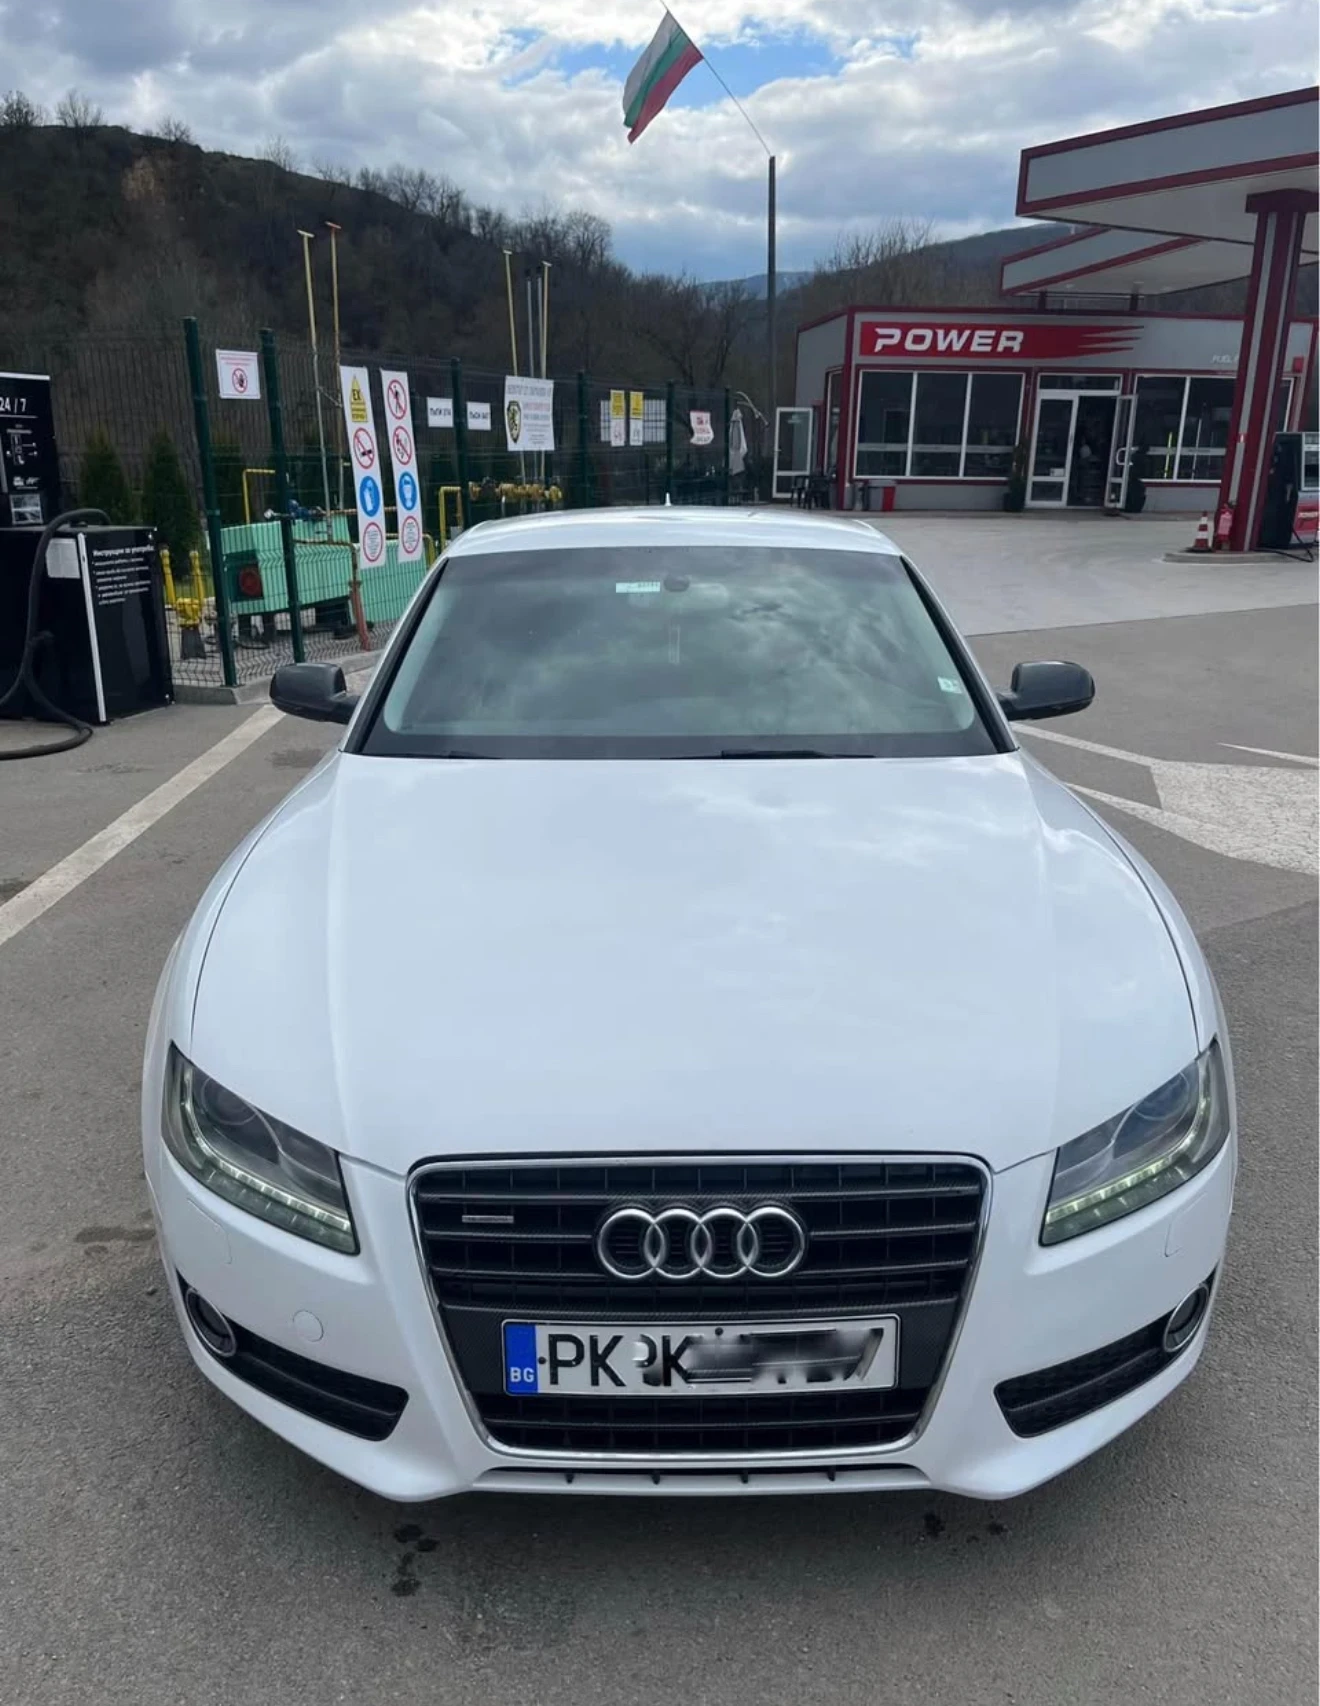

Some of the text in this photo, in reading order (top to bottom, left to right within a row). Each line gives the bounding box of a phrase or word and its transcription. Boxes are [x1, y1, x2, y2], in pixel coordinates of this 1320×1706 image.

[874, 328, 1024, 353] POWER
[548, 1333, 627, 1387] PK
[510, 1366, 535, 1383] BG
